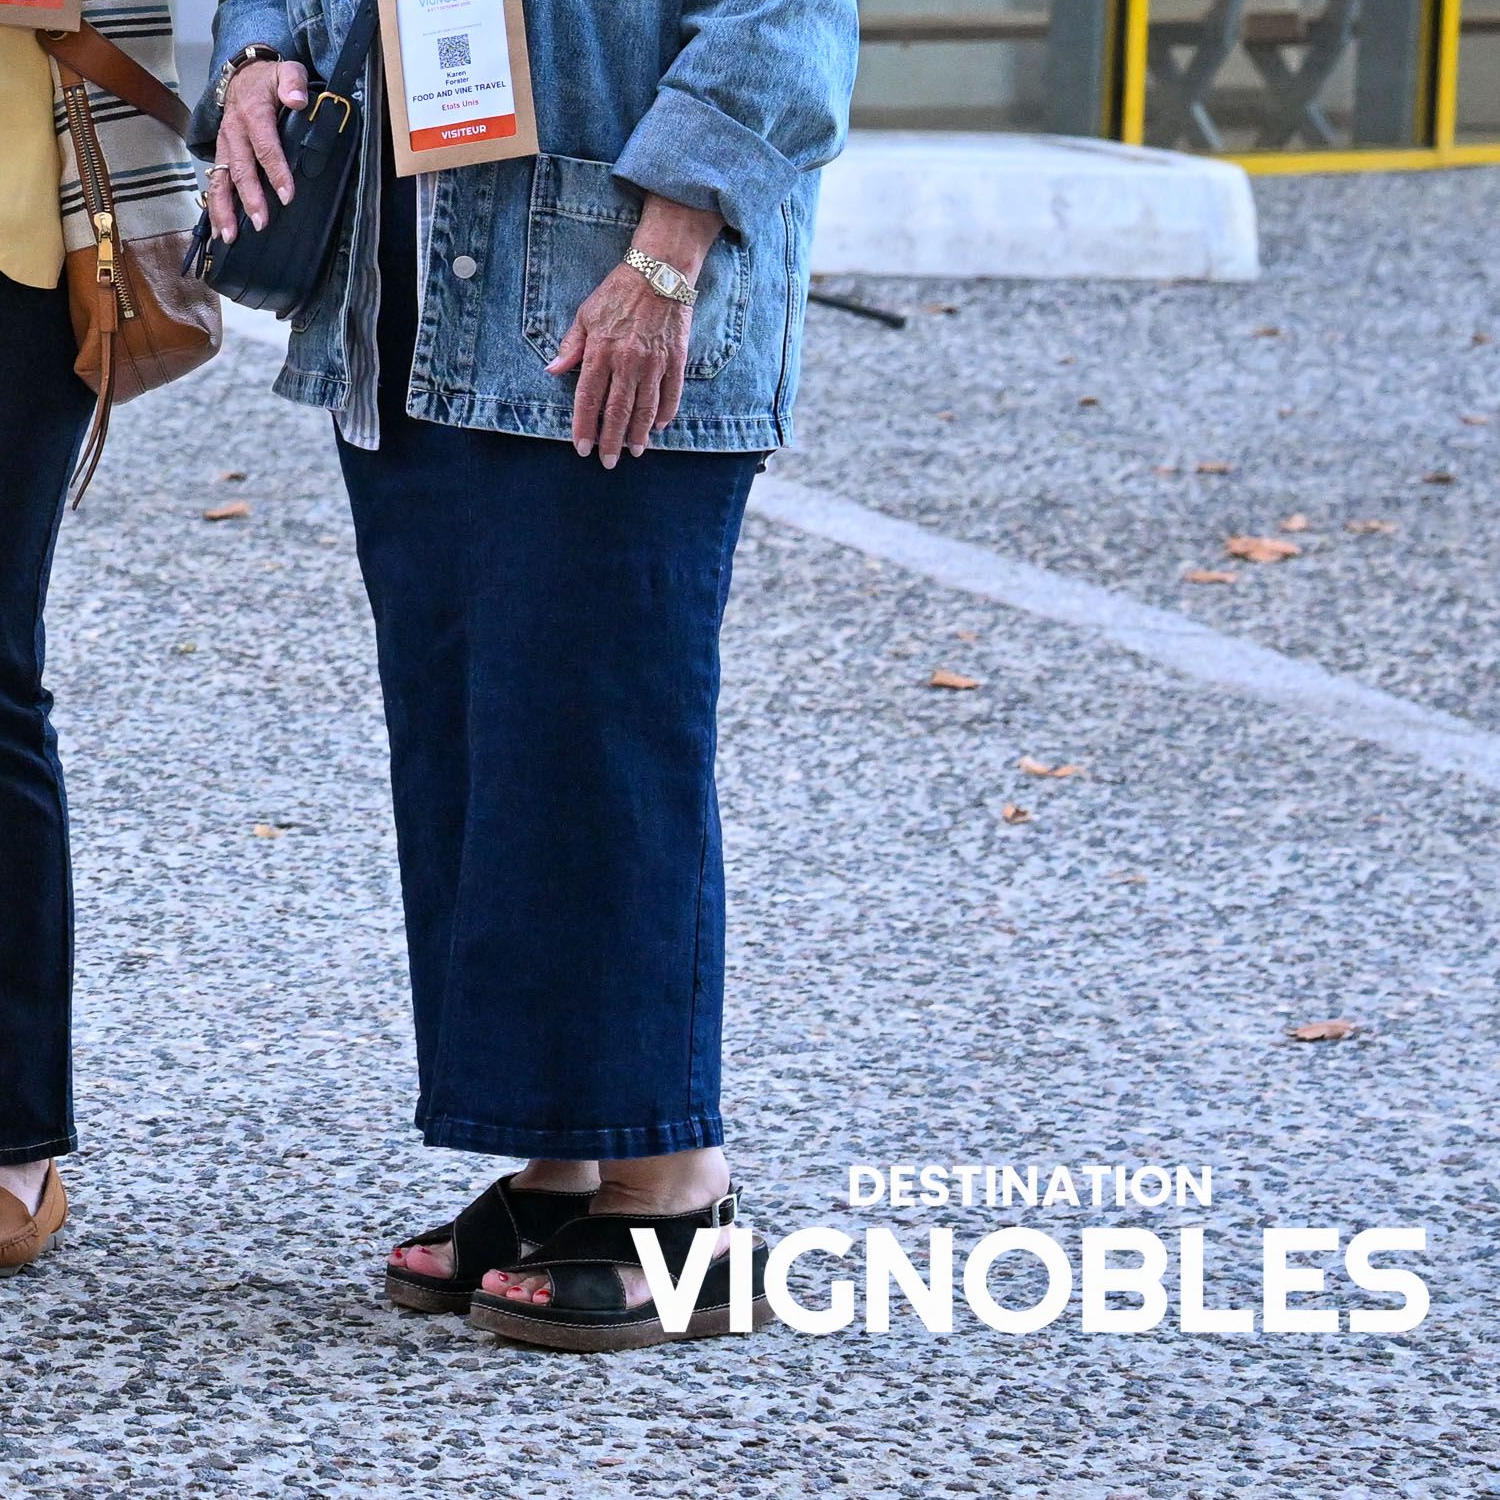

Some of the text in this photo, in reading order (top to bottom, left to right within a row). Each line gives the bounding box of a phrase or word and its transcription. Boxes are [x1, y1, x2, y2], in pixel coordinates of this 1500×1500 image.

[446, 70, 467, 78] Karen
[412, 80, 506, 103] FOOD AND VINE TRAVEL
[461, 99, 480, 108] Unis
[441, 124, 487, 140] VISITEUR
